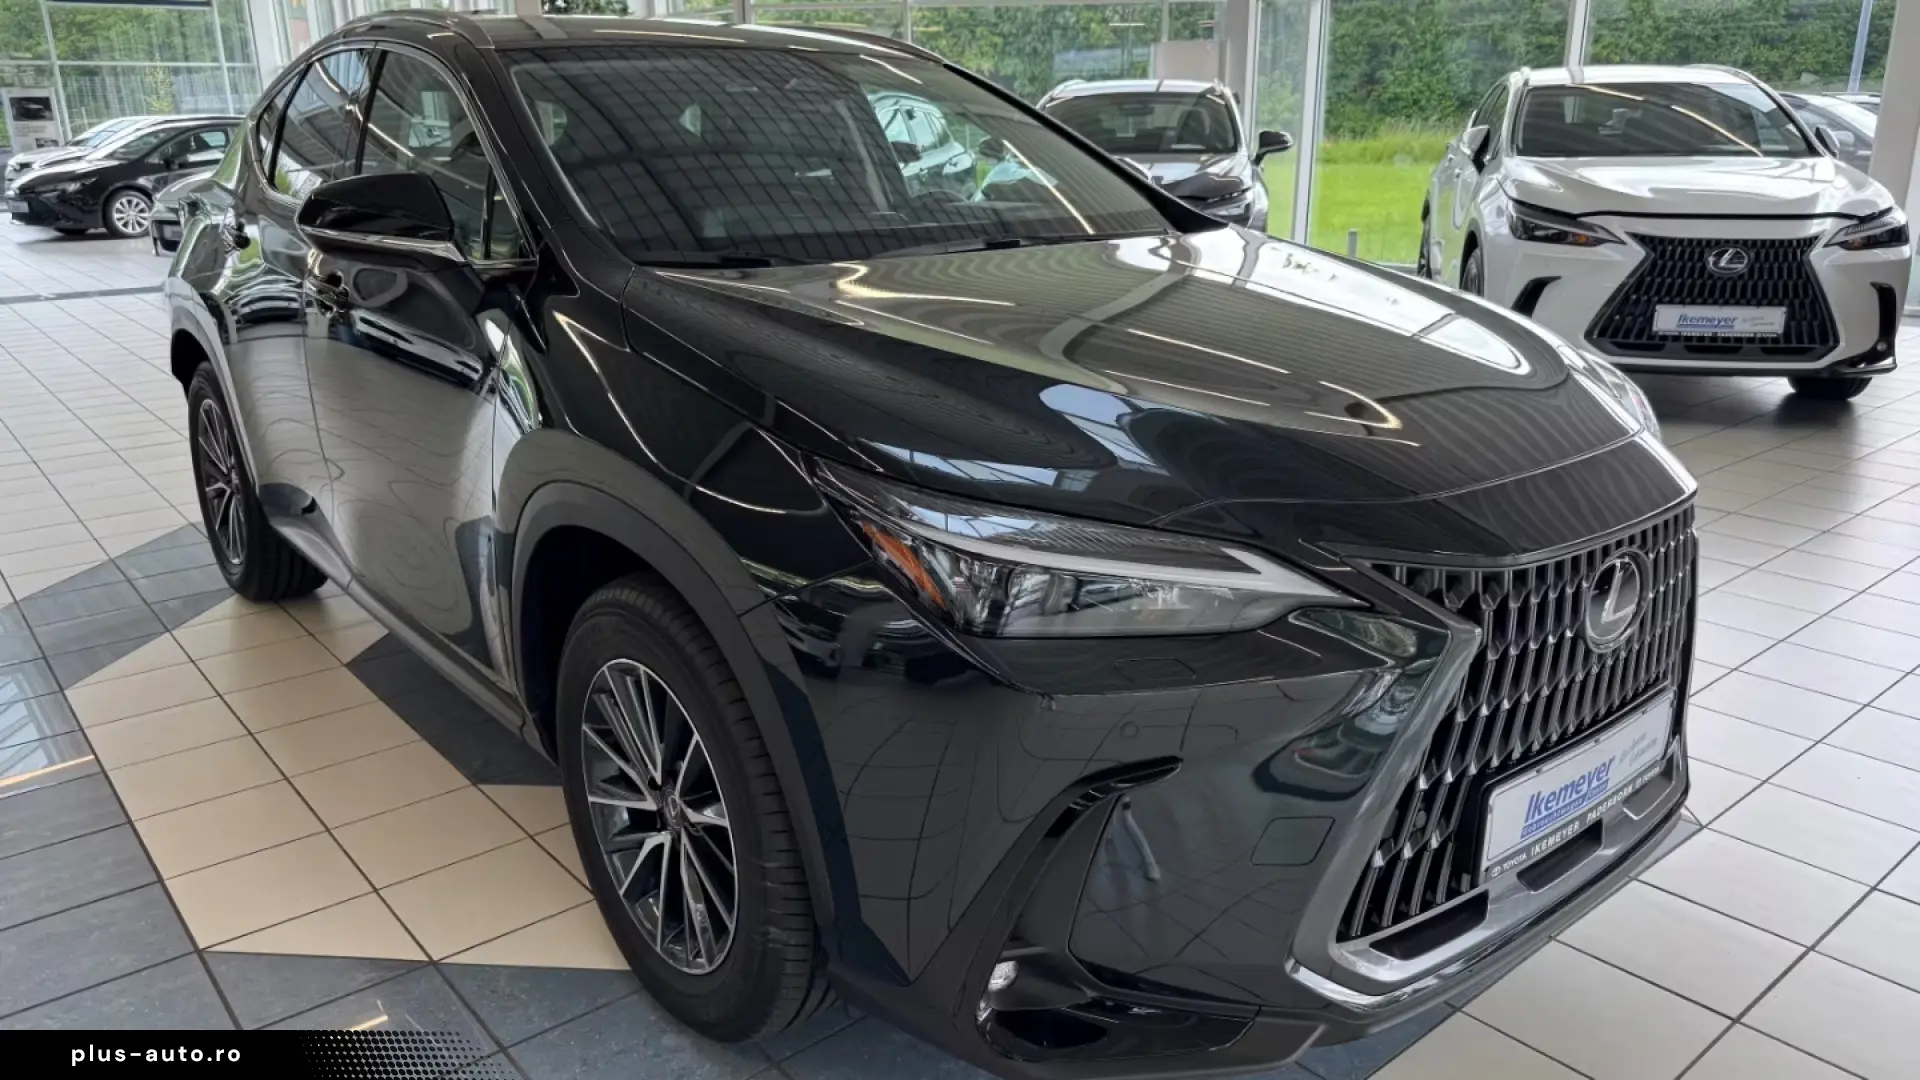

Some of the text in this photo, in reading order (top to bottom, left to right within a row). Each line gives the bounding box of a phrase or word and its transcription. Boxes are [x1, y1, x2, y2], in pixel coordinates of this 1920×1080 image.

[1678, 313, 1738, 329] Ikemeyer
[1525, 755, 1616, 824] Ikemeyer
[1502, 852, 1528, 871] TOYOTA
[1531, 820, 1580, 857] IKEMEYER
[1586, 783, 1633, 824] PADERBORN
